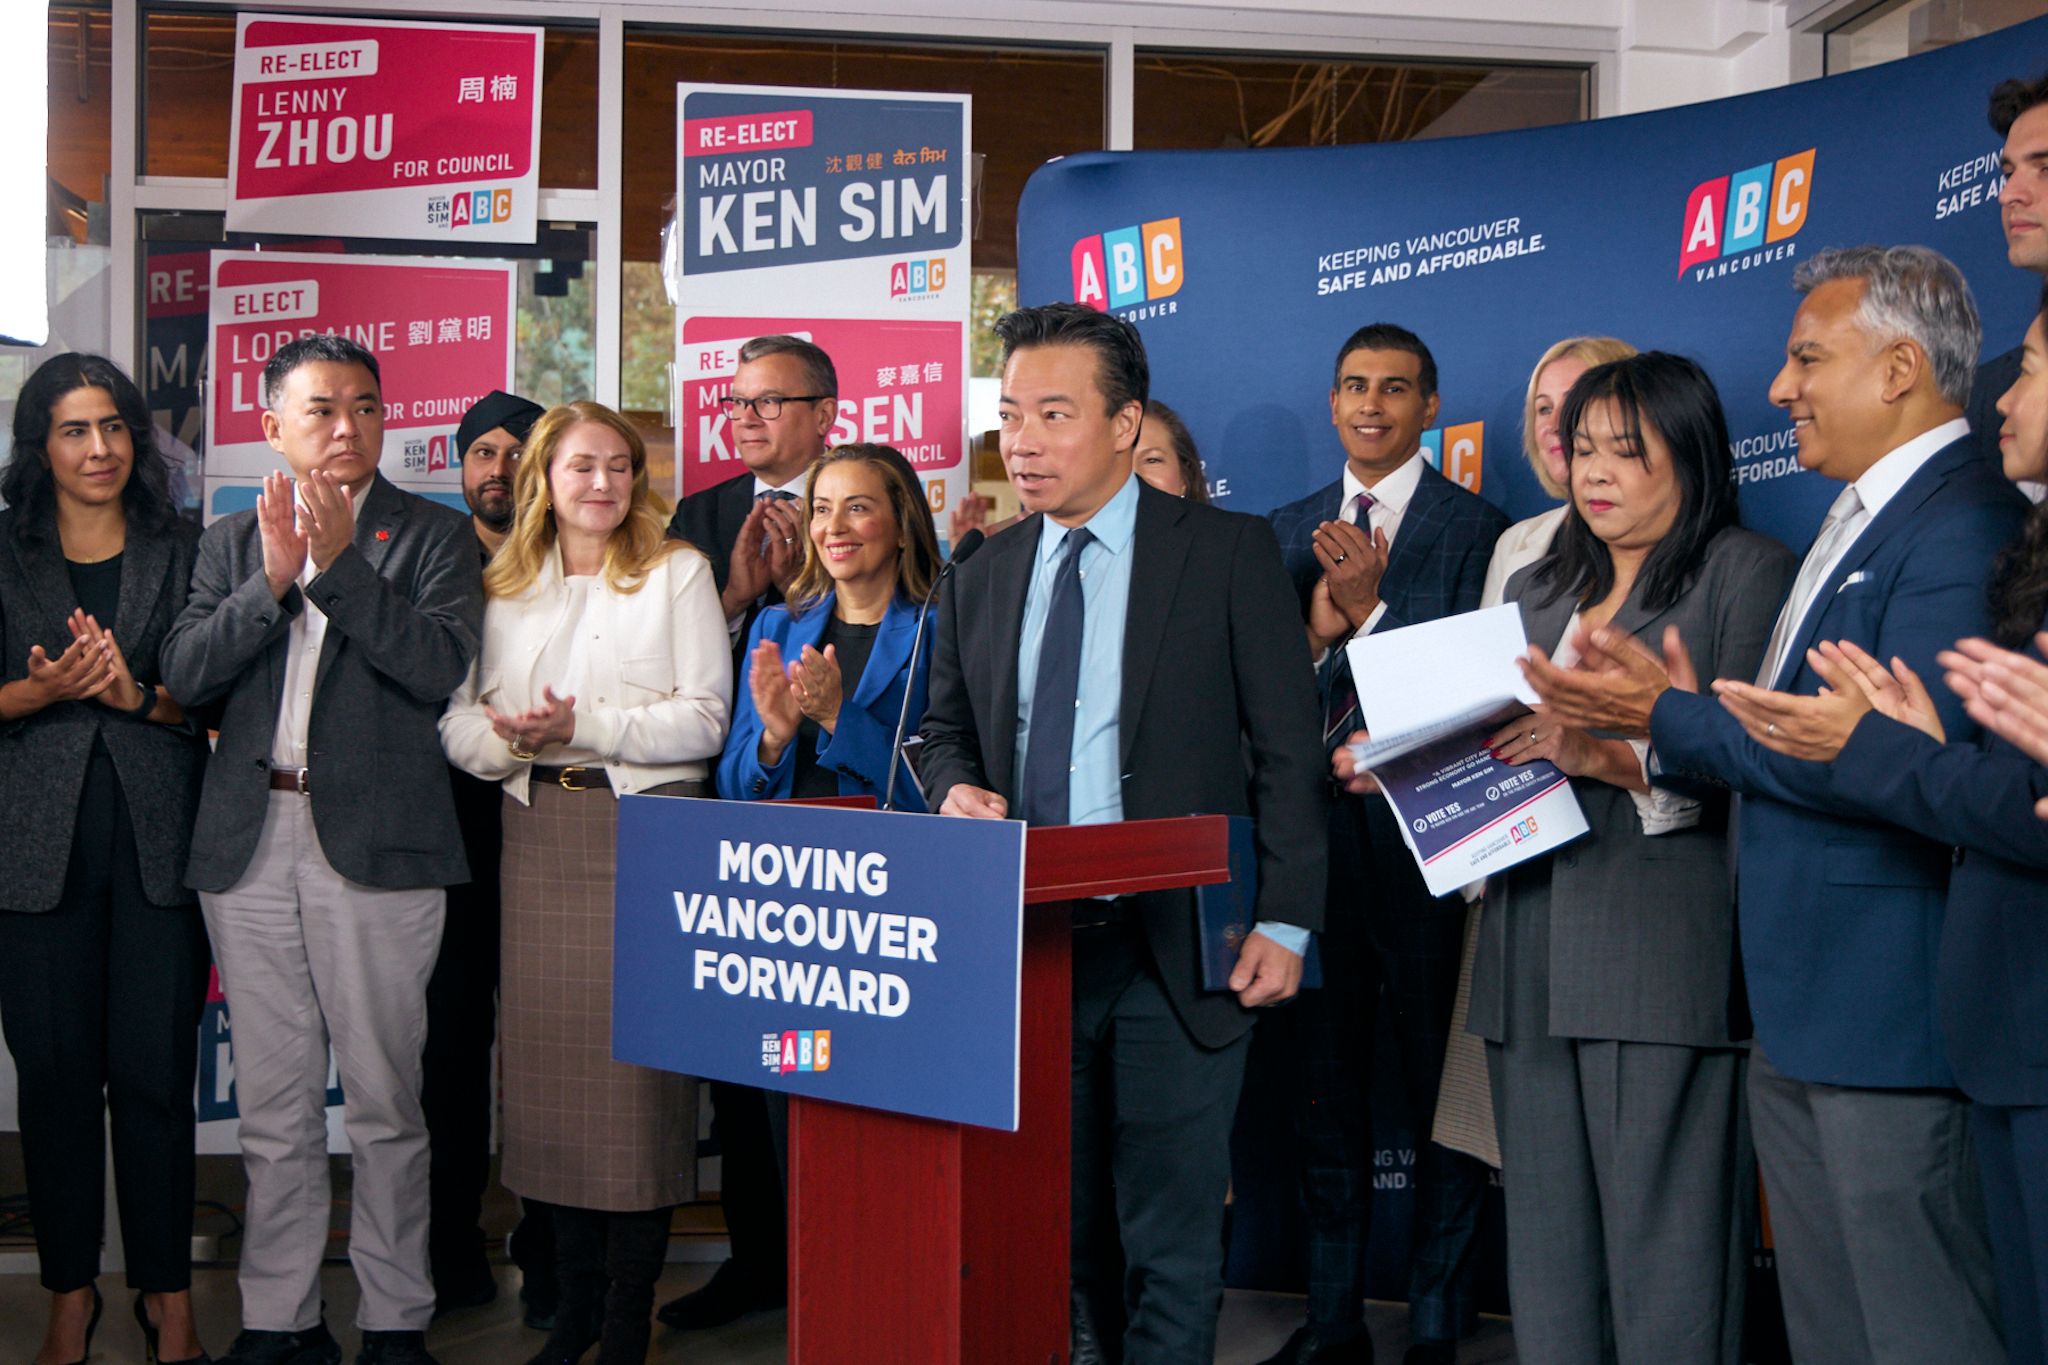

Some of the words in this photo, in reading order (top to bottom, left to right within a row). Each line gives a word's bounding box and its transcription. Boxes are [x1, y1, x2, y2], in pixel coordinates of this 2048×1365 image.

[261, 50, 362, 74] RE-ELECT
[258, 88, 347, 116] LENNY
[458, 75, 518, 104] 周楠
[255, 113, 394, 169] ZHOU
[700, 120, 798, 148] RE-ELECT
[393, 161, 428, 178] FOR
[437, 153, 514, 176] COUNCIL
[700, 157, 786, 188] MAYOR
[1938, 147, 2004, 192] KEEPIN
[428, 201, 449, 212] KEN
[454, 194, 509, 222] ABC
[699, 187, 817, 257] KEN
[839, 174, 948, 242] SIM
[1686, 167, 1805, 253] ABC
[1935, 184, 1982, 219] SAFE
[427, 212, 449, 224] SIM
[1318, 242, 1400, 272] KEEPING
[1406, 217, 1520, 256] VANCOUVER
[893, 263, 943, 290] ABC
[1079, 233, 1176, 303] ABC
[1317, 271, 1367, 295] SAFE
[1370, 262, 1411, 286] AND
[1416, 234, 1546, 277] AFFORDABLE.
[1696, 243, 1795, 282] VANCOUVER
[234, 290, 304, 315] ELECT
[1120, 301, 1178, 324] COUVER
[408, 315, 492, 346] 劉黛明
[876, 362, 944, 388] 麥嘉信
[404, 456, 426, 468] SIM
[405, 444, 426, 456] KEN
[1498, 775, 1520, 792] VOTE
[1517, 769, 1534, 783] YES
[1425, 808, 1446, 824] VOTE
[1444, 801, 1461, 815] YES
[718, 840, 888, 896] MOVING
[673, 891, 938, 963] VANCOUVER
[693, 949, 910, 1018] FORWARD
[762, 1040, 781, 1053] KEN
[783, 1037, 827, 1065] ABC
